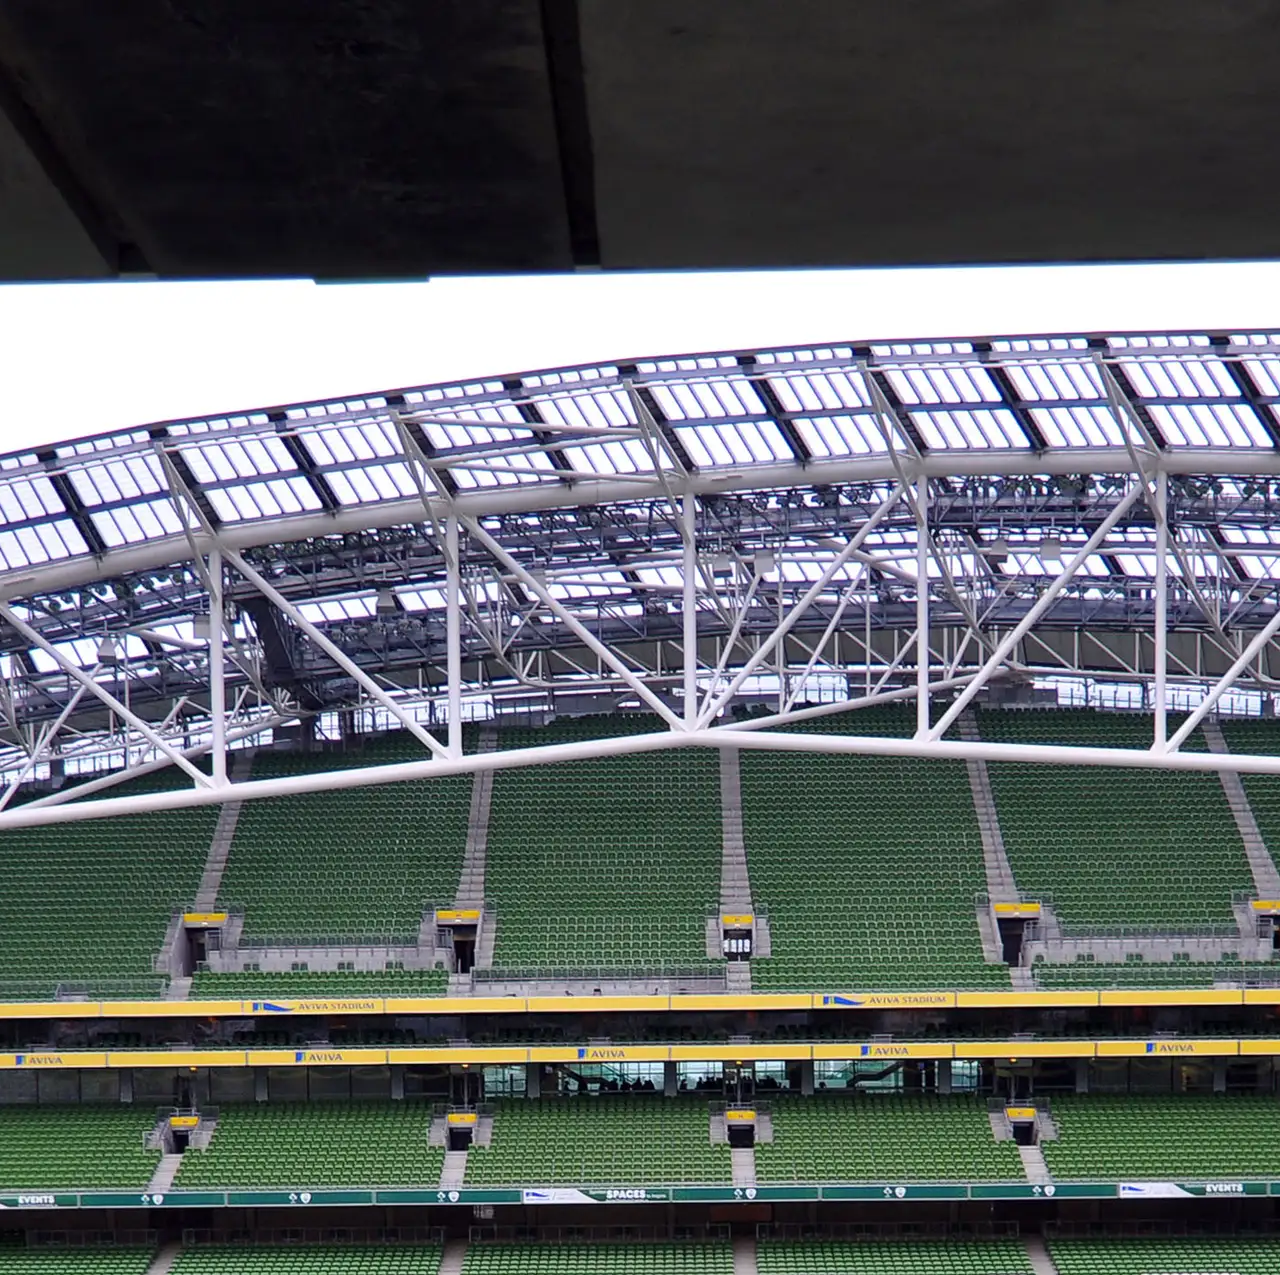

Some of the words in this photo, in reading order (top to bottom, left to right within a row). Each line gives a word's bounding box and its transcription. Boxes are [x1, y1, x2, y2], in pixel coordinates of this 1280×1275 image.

[902, 996, 946, 1004] STADIUM
[299, 1003, 329, 1011] AVIVA
[331, 1002, 375, 1010] STADIUM
[874, 1047, 909, 1055] AVIVA
[1159, 1044, 1194, 1052] AVIVA
[309, 1053, 343, 1062] AVIVA
[591, 1050, 625, 1058] AVIVA
[29, 1056, 63, 1065] AVIVA
[606, 1190, 645, 1199] SPACES
